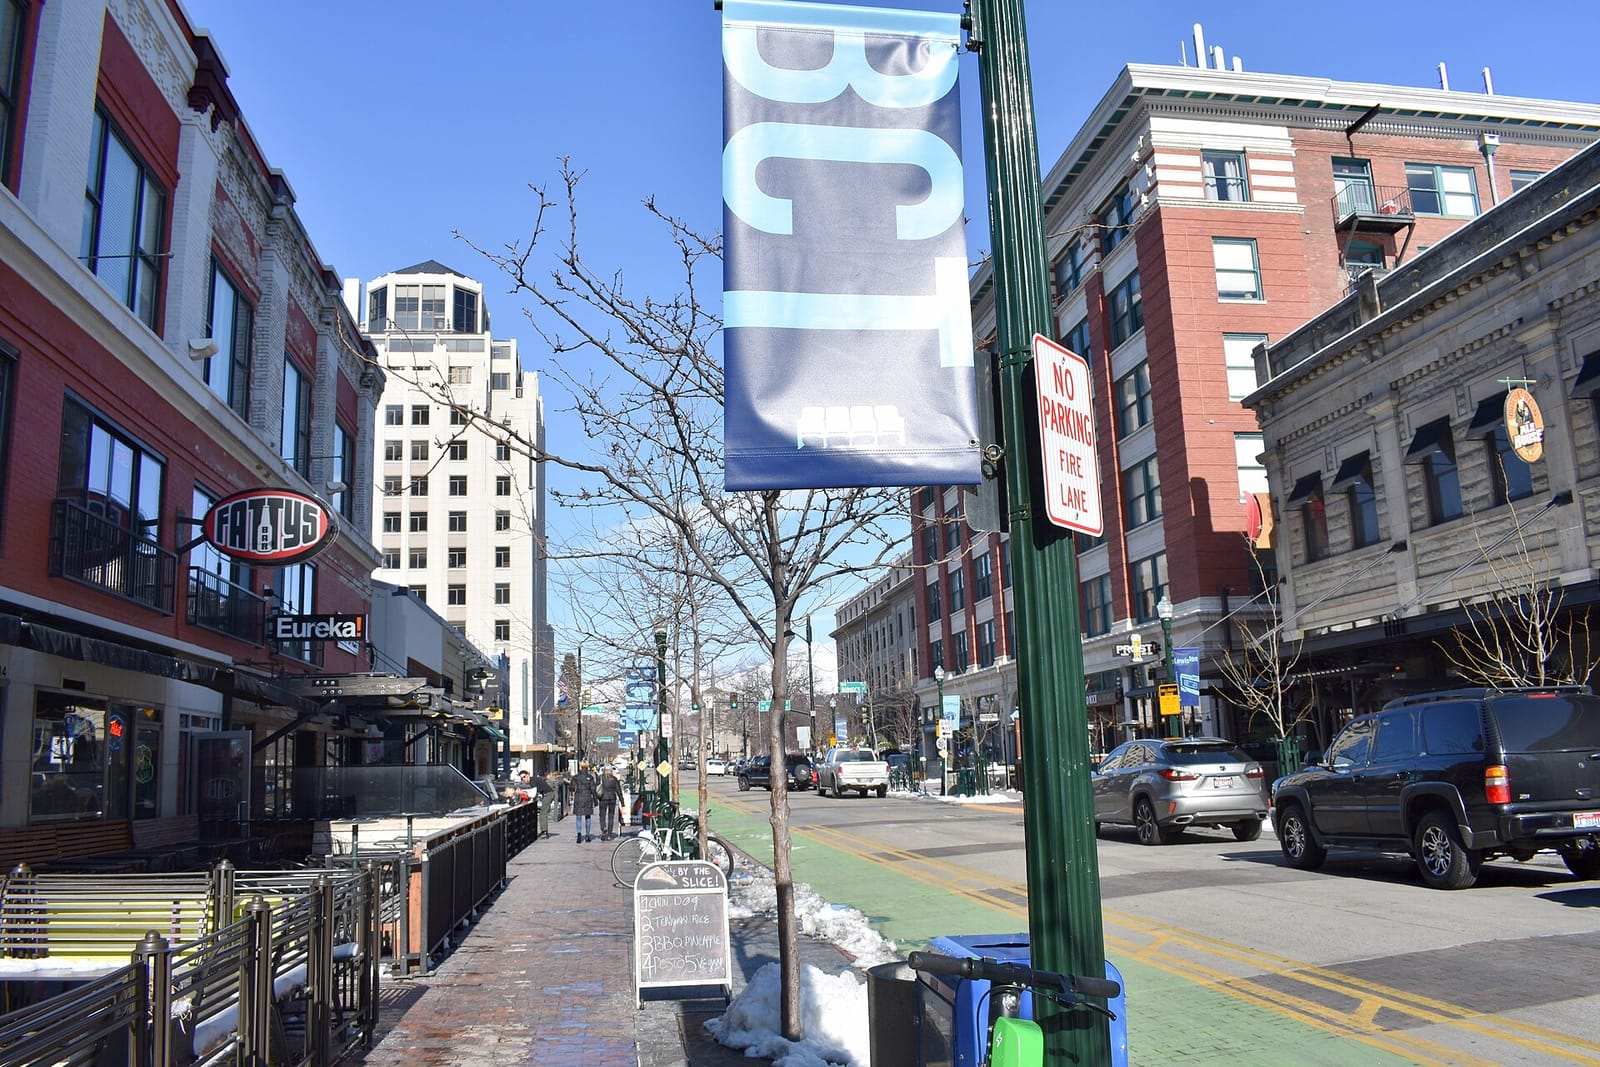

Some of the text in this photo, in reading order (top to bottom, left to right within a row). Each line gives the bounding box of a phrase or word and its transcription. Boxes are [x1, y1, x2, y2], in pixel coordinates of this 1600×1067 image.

[1052, 361, 1075, 401] NO
[1042, 395, 1092, 447] PARKING
[1059, 449, 1084, 479] FIRE
[1060, 483, 1088, 513] LANE
[214, 497, 321, 552] FATTYS
[261, 526, 269, 550] BAR
[276, 616, 362, 638] Eureka!
[677, 867, 689, 876] BY
[693, 867, 710, 875] THE
[682, 875, 719, 888] SLICE!
[641, 915, 655, 932] 2
